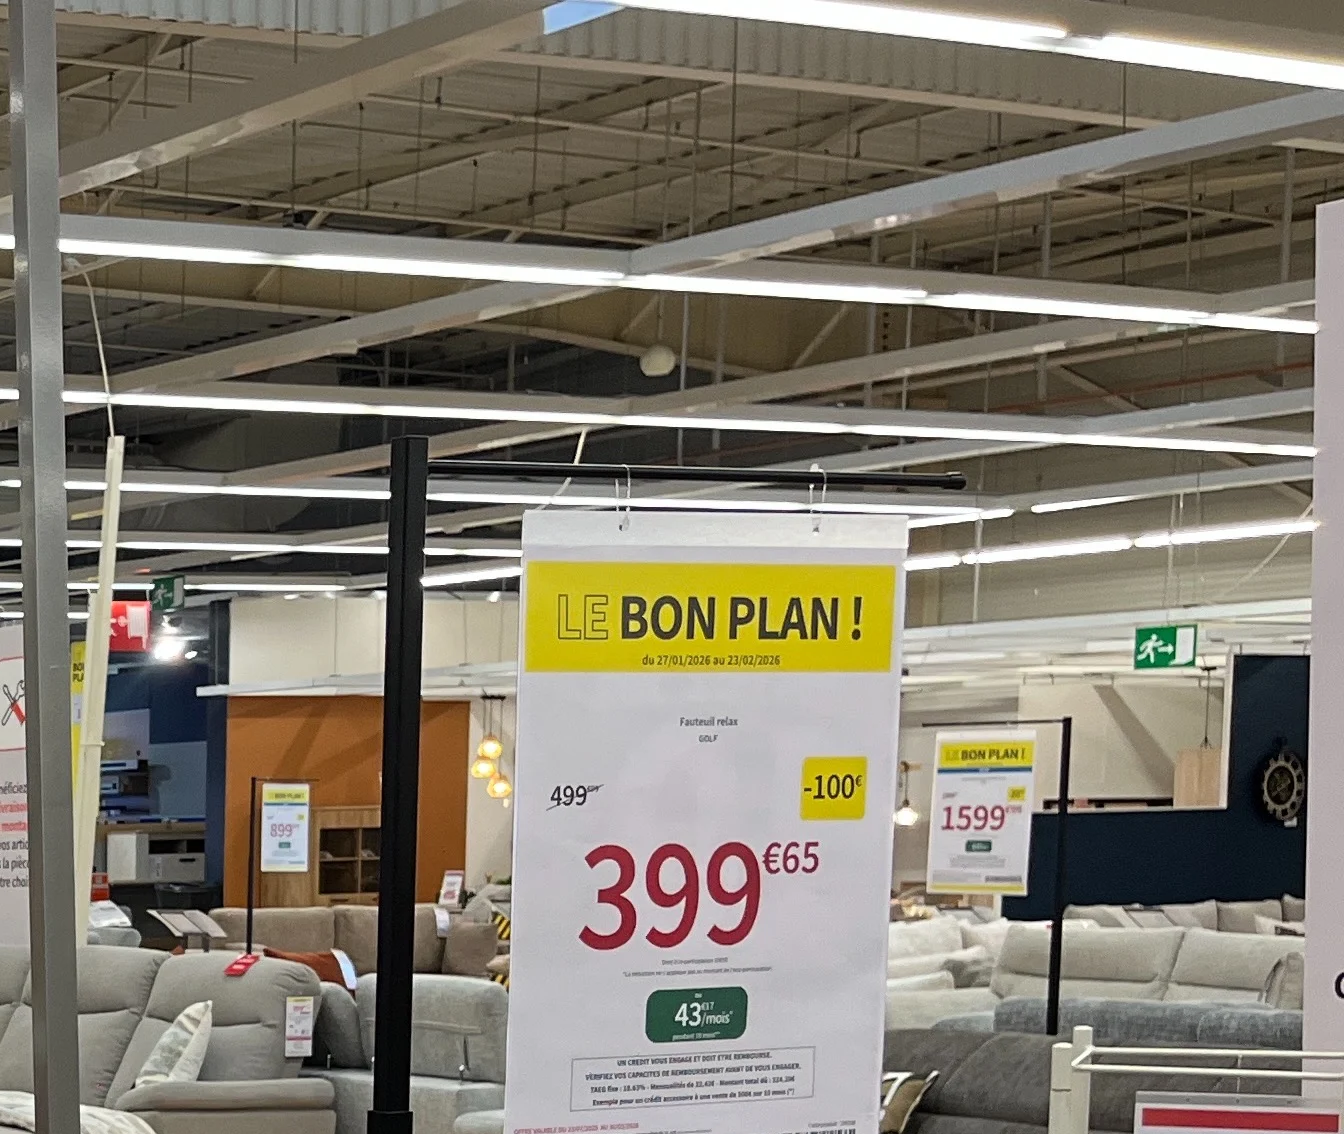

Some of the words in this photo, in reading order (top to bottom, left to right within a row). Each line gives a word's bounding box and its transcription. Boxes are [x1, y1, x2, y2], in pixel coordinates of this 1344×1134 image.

[558, 593, 609, 640] LE
[620, 595, 716, 641] BON
[728, 596, 839, 641] PLAN
[851, 596, 863, 641] !
[642, 655, 655, 666] du
[656, 655, 711, 667] 27/01/2026
[712, 657, 726, 666] au
[727, 655, 781, 667] 23/02/2026
[679, 716, 715, 727] Fauteuil
[716, 716, 739, 727] relax
[961, 749, 986, 760] BON
[988, 748, 1019, 760] PLAN
[803, 774, 862, 800] -100€
[941, 805, 1006, 832] 1599
[1, 821, 28, 833] monta
[11, 855, 30, 872] pièc
[11, 874, 29, 888] choi
